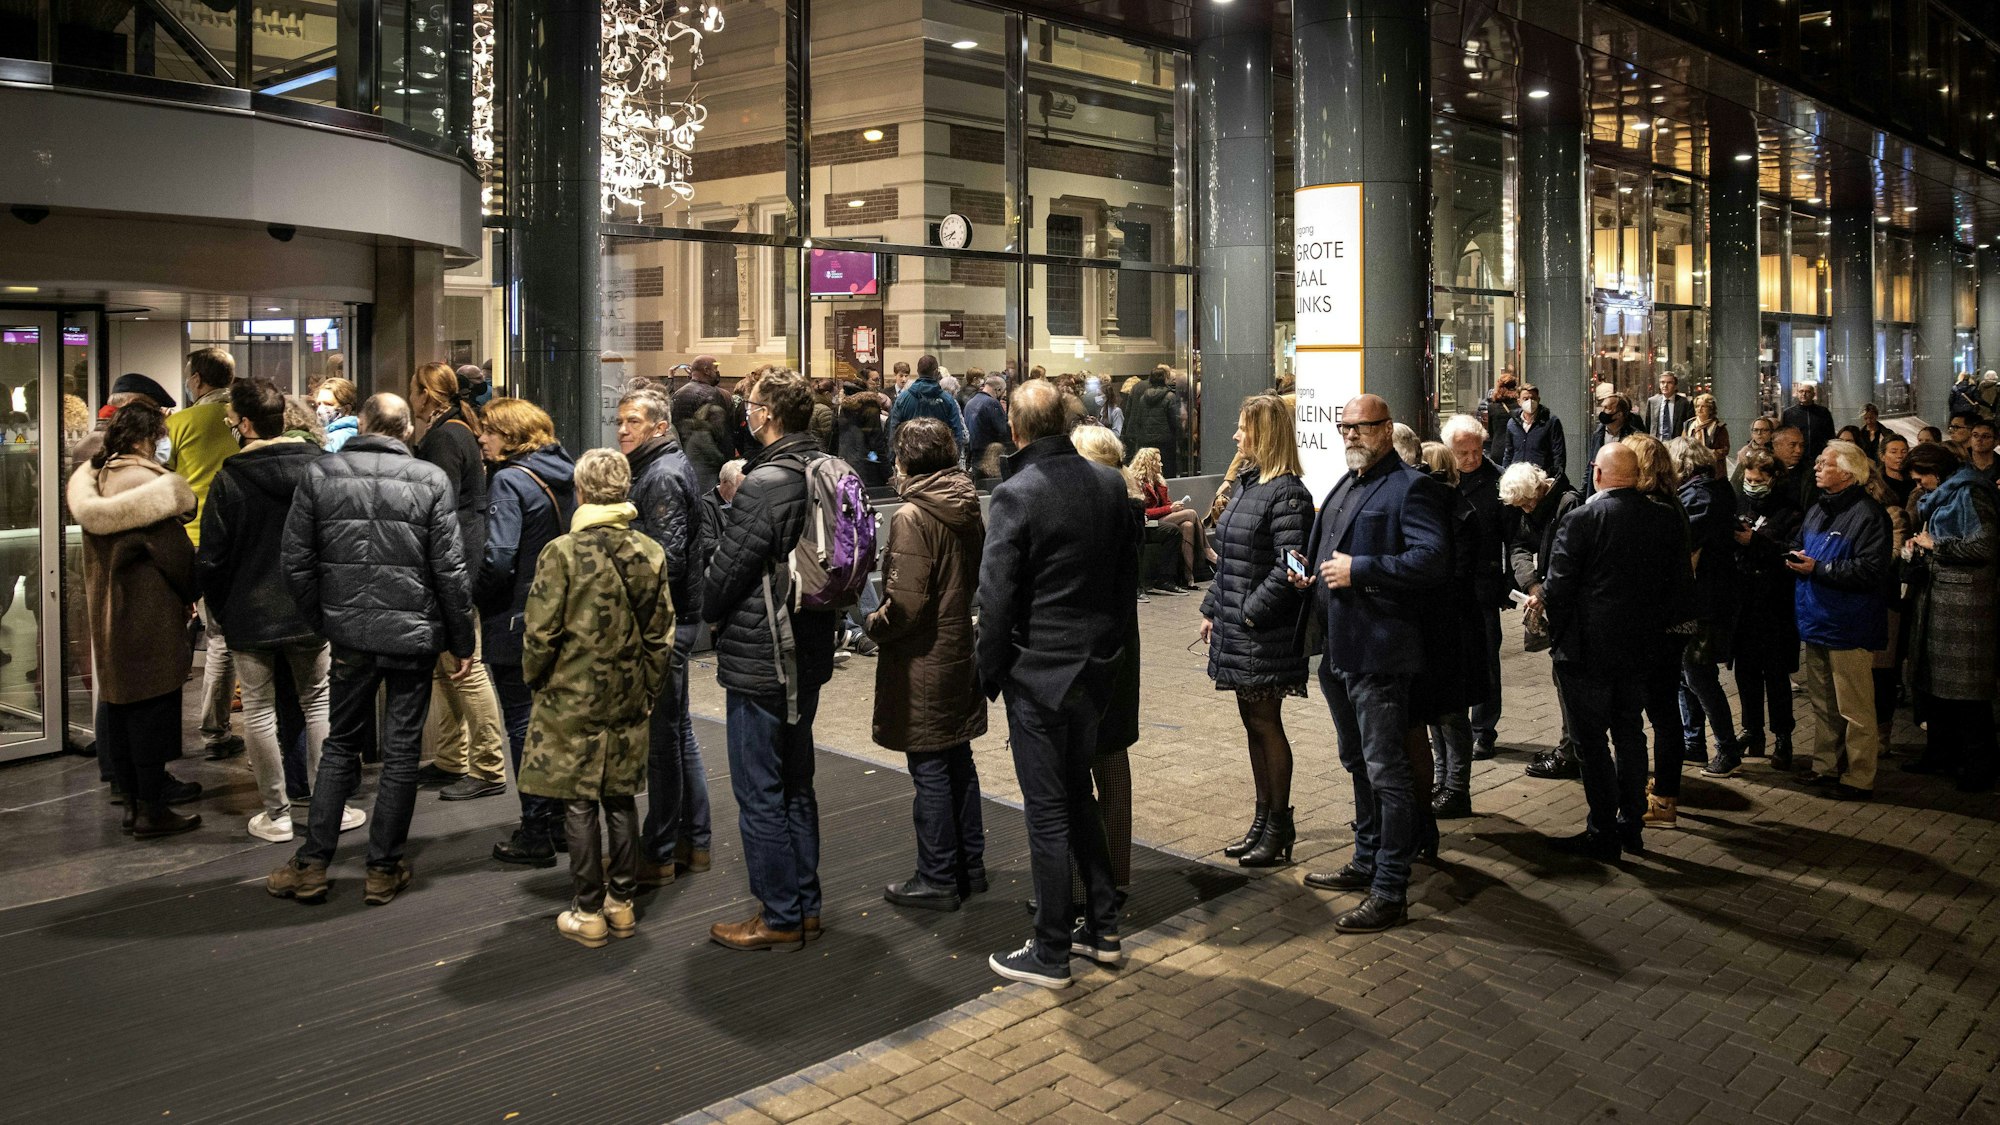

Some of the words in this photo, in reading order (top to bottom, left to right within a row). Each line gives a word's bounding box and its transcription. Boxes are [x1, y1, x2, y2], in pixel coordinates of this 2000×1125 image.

[1296, 241, 1344, 261] GROTE
[1297, 269, 1327, 287] ZAAL
[1297, 295, 1332, 314] LINKS
[1297, 405, 1344, 423] KLEINE
[1297, 431, 1328, 450] ZAAL
